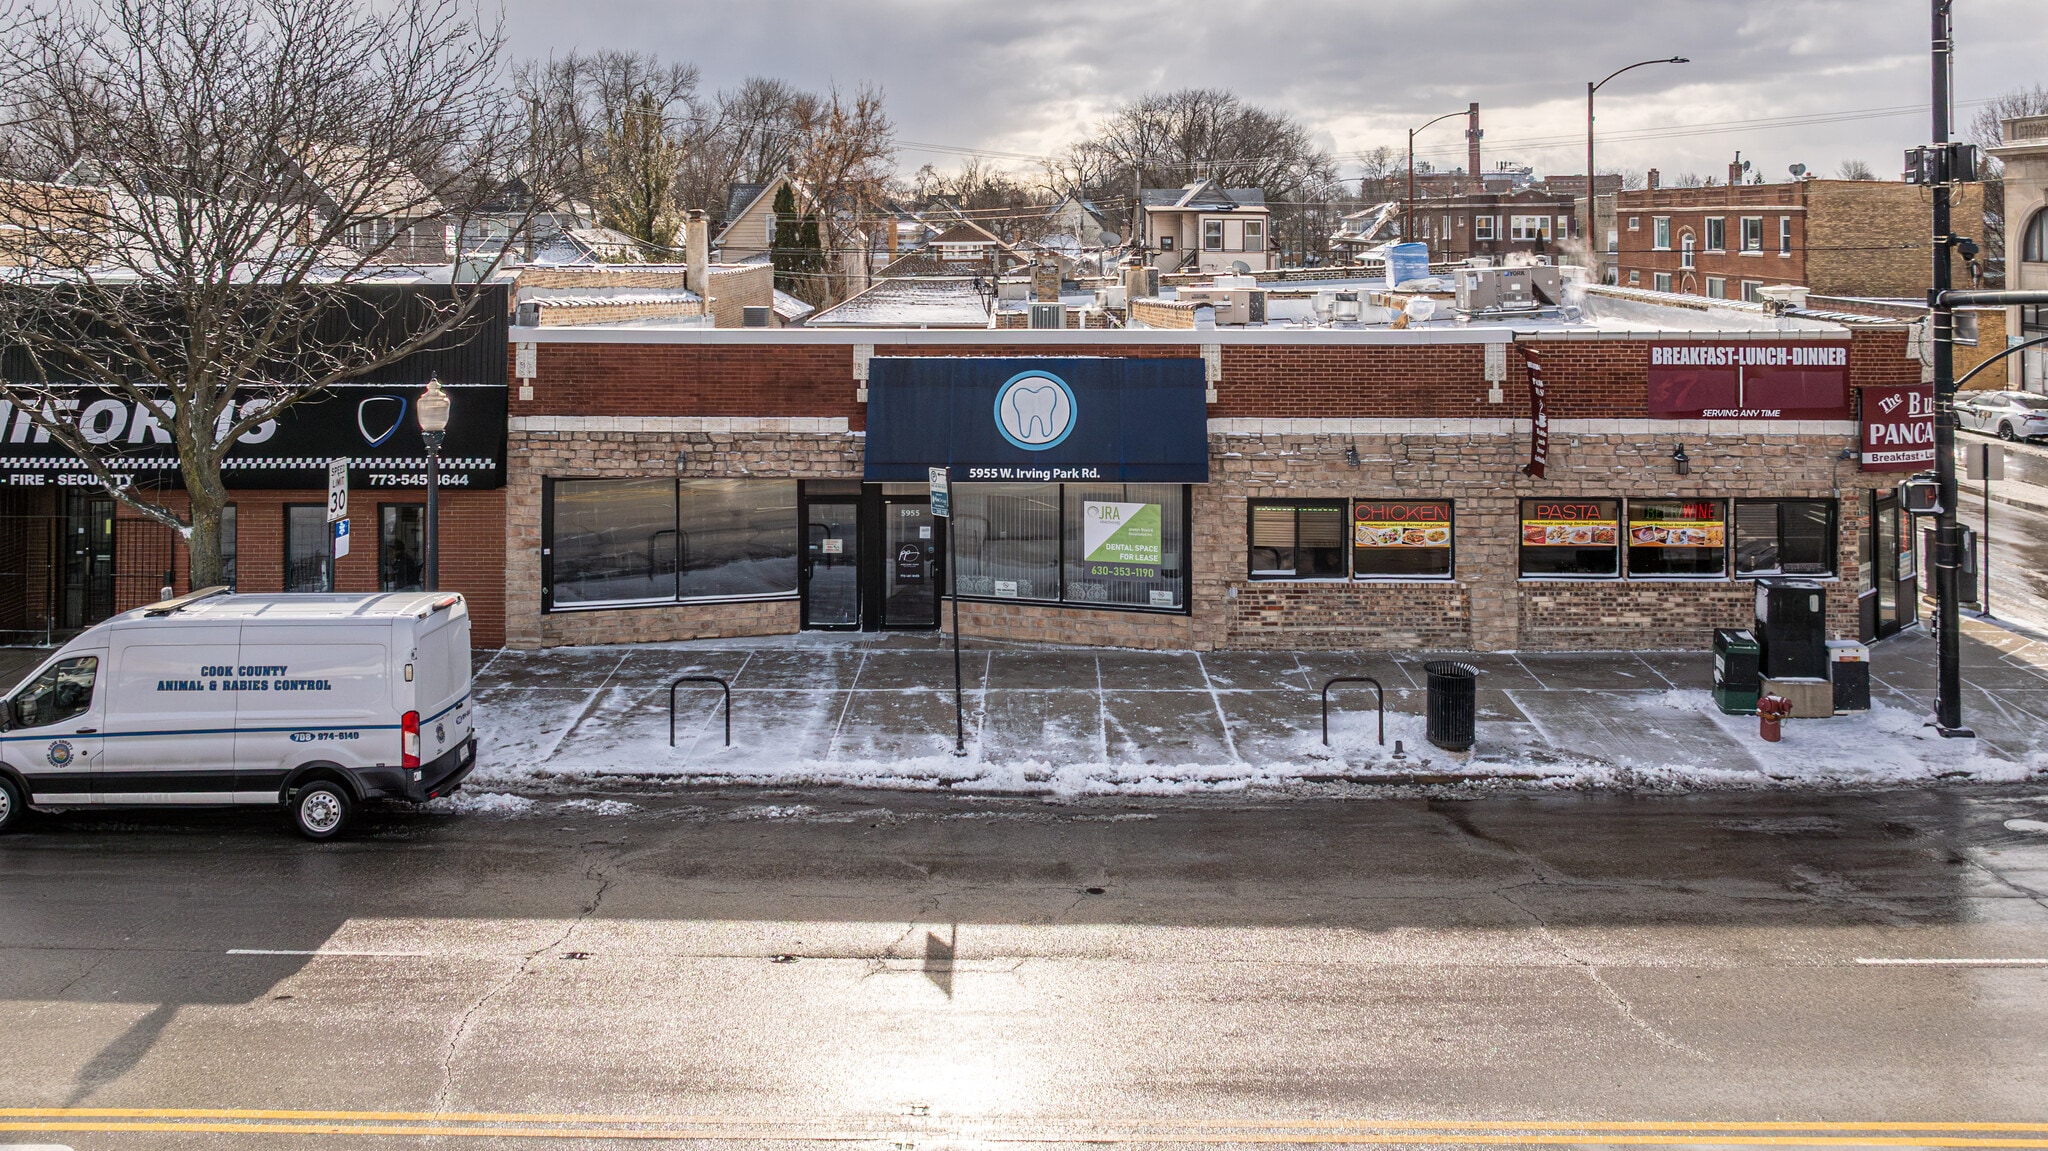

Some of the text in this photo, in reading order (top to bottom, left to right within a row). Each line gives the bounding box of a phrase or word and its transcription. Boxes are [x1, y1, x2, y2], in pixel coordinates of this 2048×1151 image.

[1652, 347, 1847, 366] BREAKFAST-LUNCH-DINNER
[1878, 393, 1904, 414] The
[1702, 409, 1781, 418] SERVING ANY TIME
[1871, 452, 1919, 462] Breakfast
[10, 474, 45, 486] FIRE
[969, 467, 1101, 481] 5955 W. Irving Park Rd.
[330, 489, 346, 513] 30
[901, 509, 921, 517] 5955
[1099, 505, 1121, 521] JRA
[1355, 505, 1449, 521] CHICKEN
[1537, 504, 1601, 520] PASTA
[1105, 543, 1158, 552] DENTAL SPACE
[1135, 553, 1158, 562] LEASE
[1091, 566, 1154, 577] 630-353-1190
[201, 665, 288, 677] COOK COUNTY
[157, 679, 332, 691] ANIMAL & RABIES CONTROL
[294, 732, 312, 741] 708
